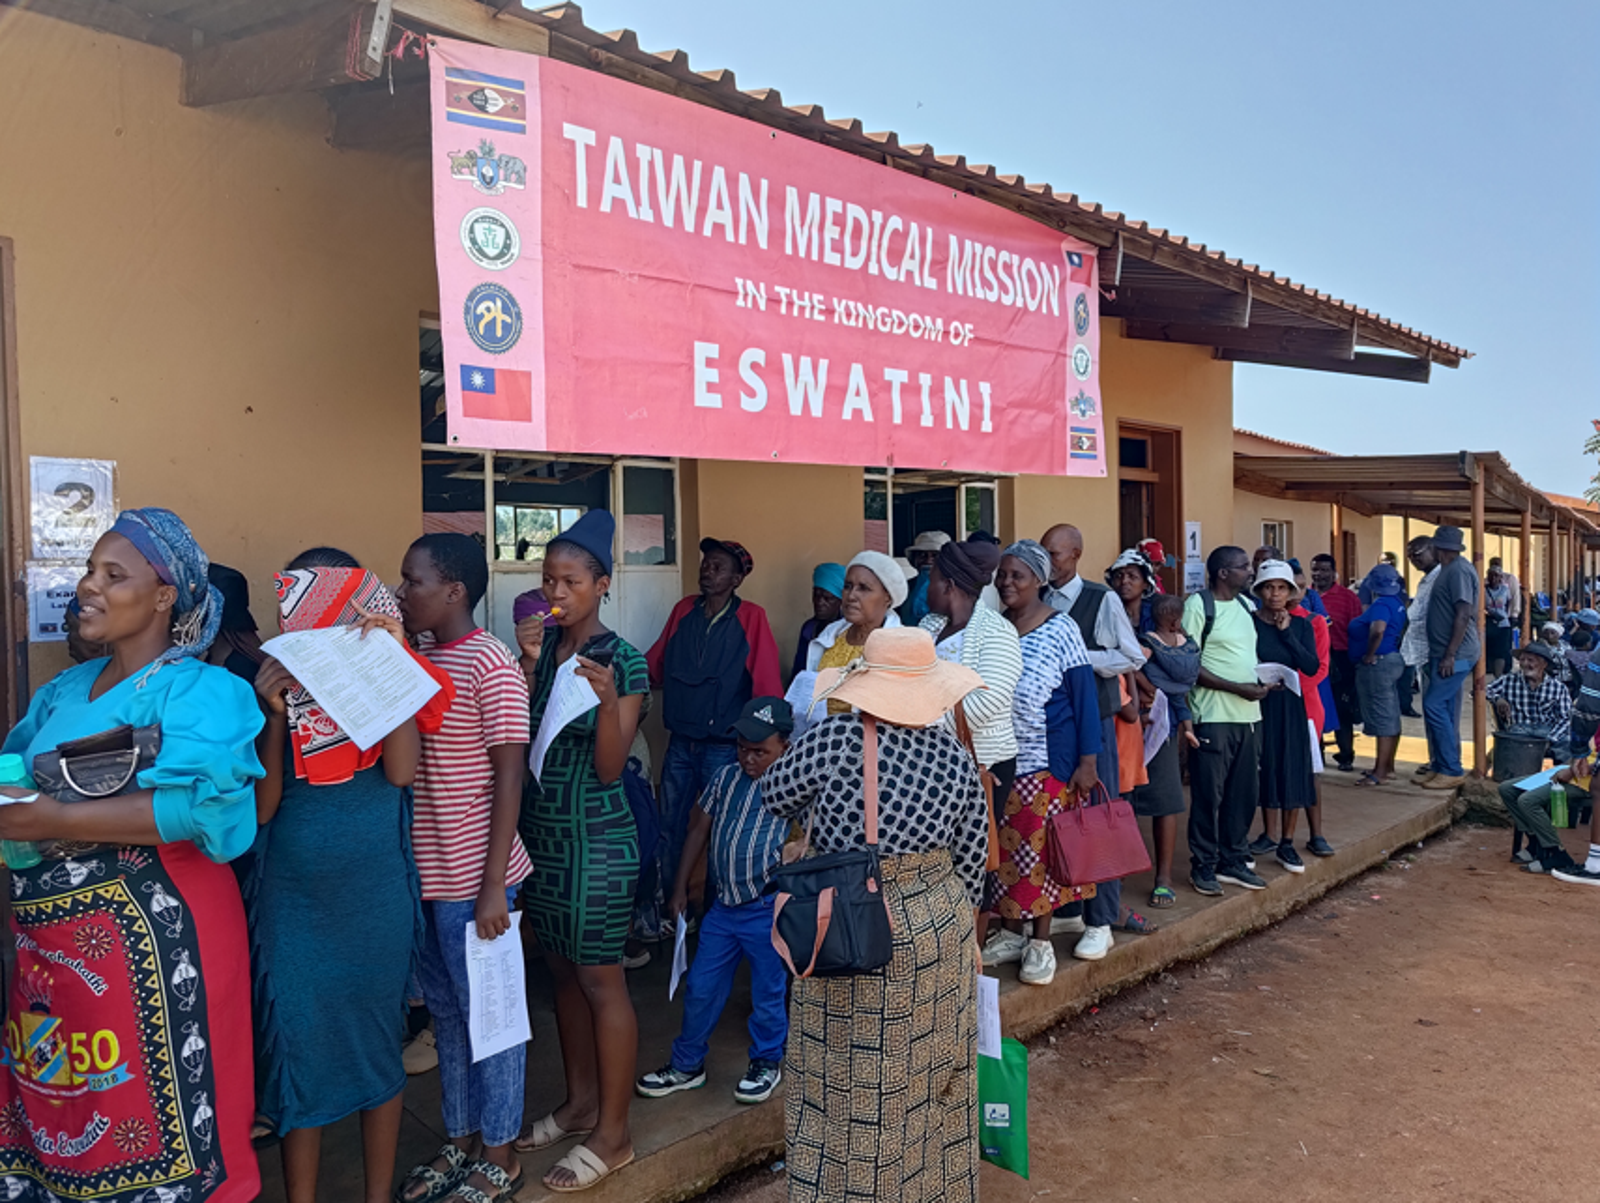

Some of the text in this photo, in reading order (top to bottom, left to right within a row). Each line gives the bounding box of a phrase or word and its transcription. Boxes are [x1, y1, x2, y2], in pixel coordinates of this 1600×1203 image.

[562, 121, 770, 251] TAIWAN
[784, 184, 938, 291] MEDICAL
[946, 234, 1061, 318] MISSION
[734, 276, 975, 347] IN THE KINGDOM OF
[693, 340, 993, 433] ESWATINI
[53, 481, 95, 528] 2
[1189, 530, 1197, 551] 1
[71, 1029, 120, 1072] 50
